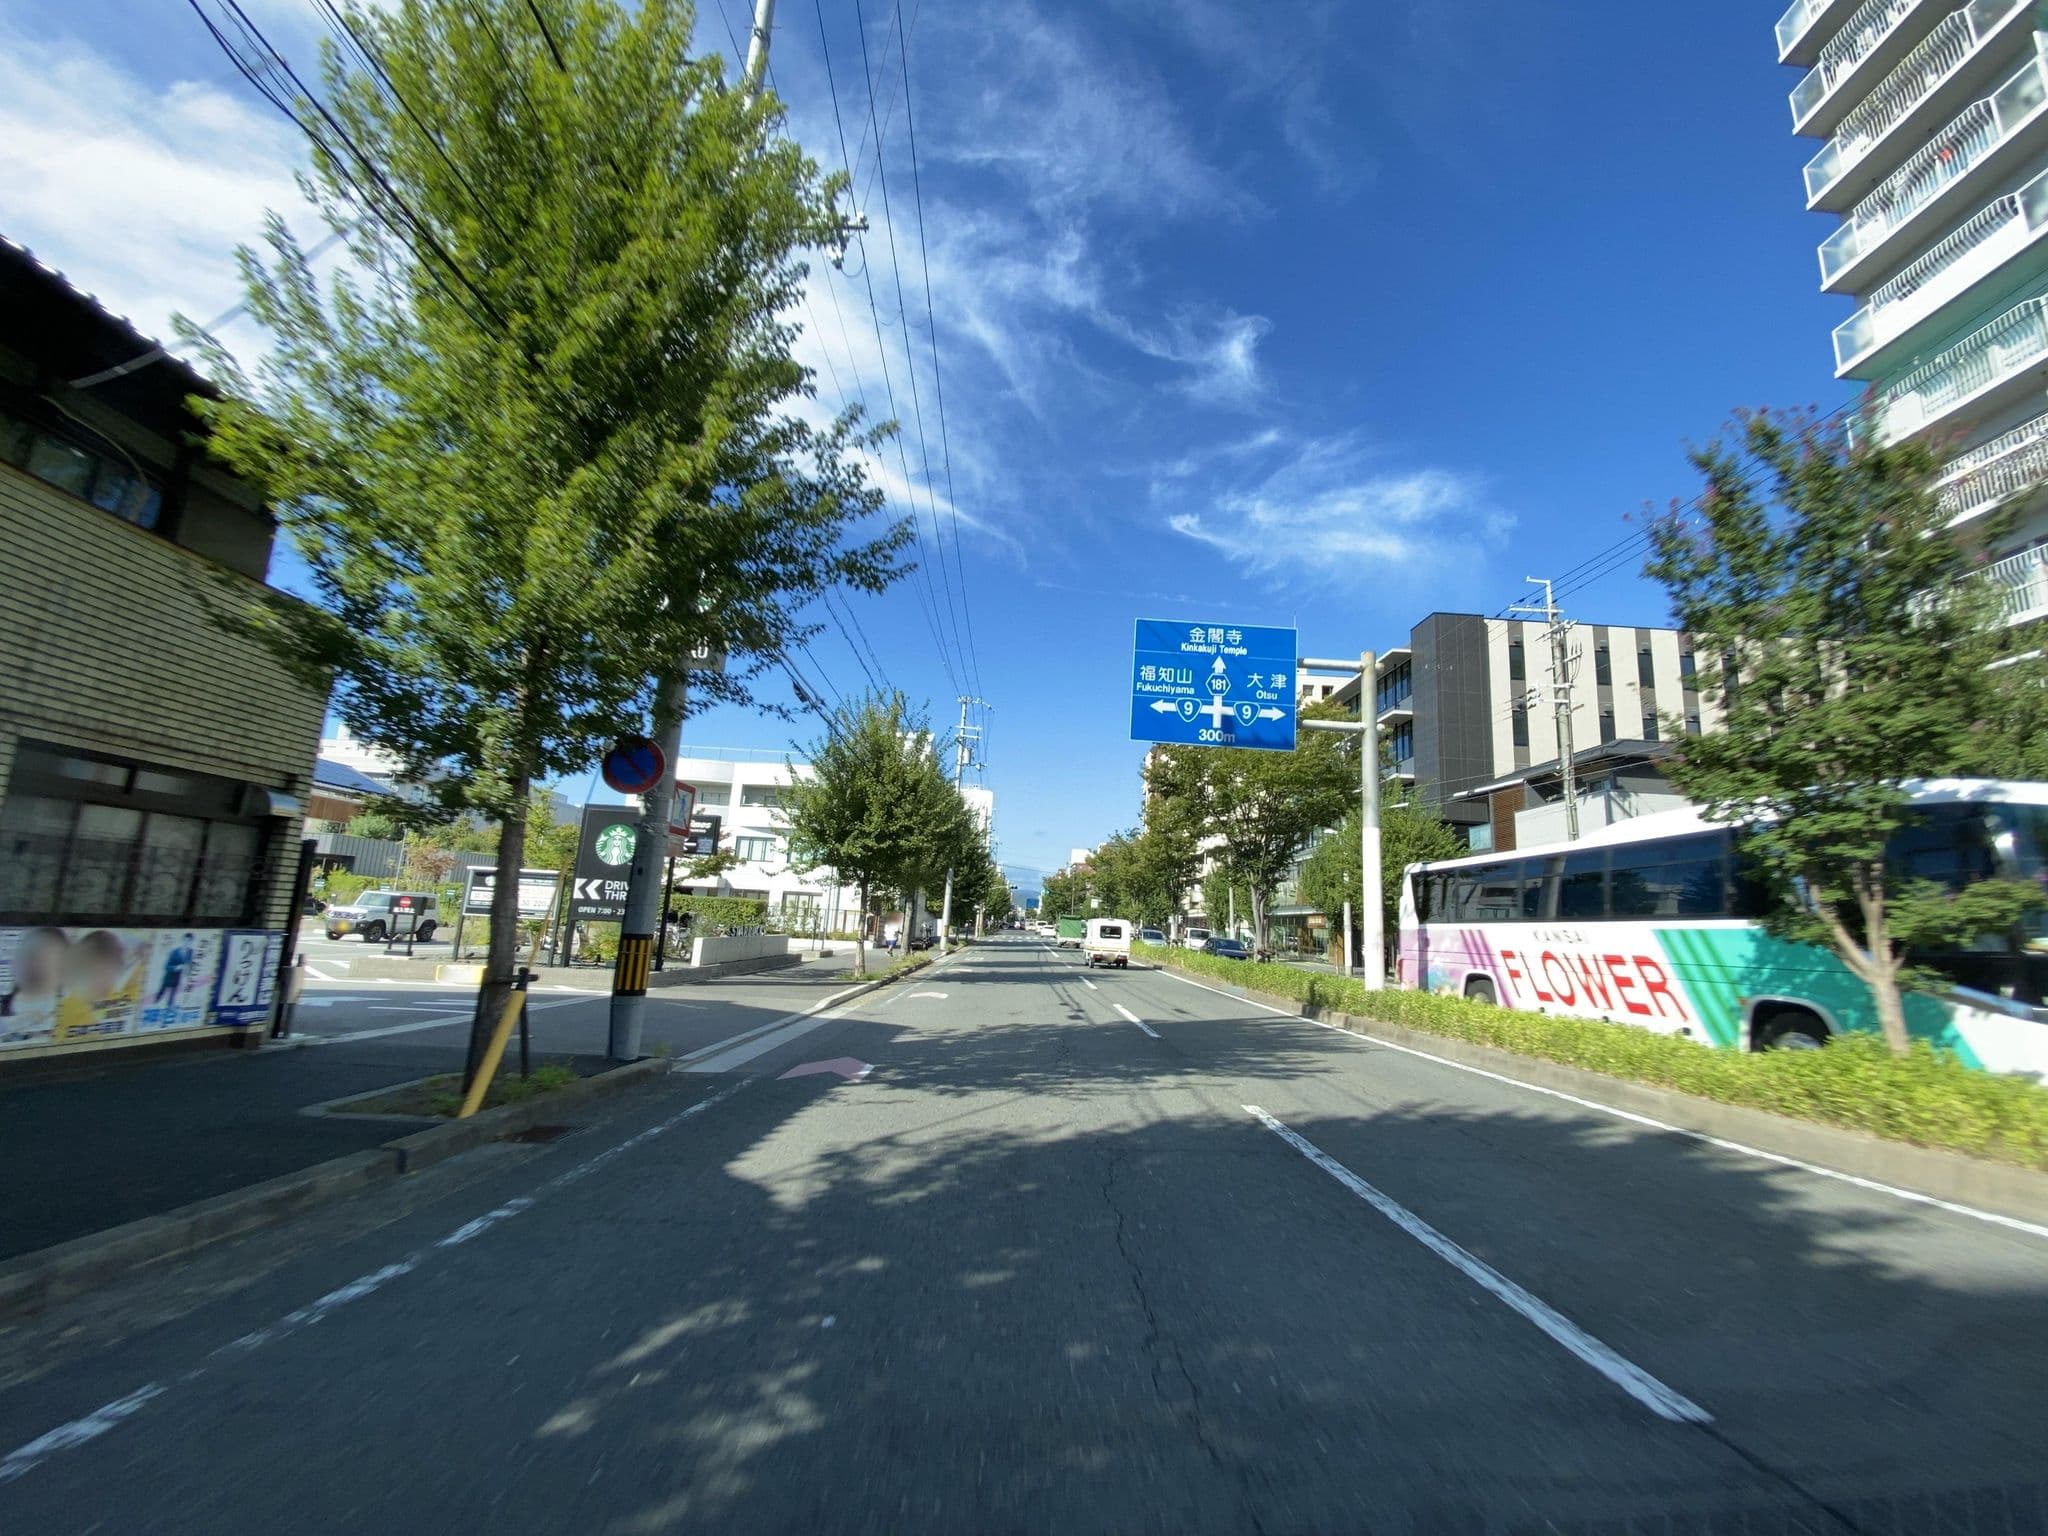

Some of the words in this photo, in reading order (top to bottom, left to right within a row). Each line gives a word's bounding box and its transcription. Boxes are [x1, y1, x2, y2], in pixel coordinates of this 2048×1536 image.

[1189, 626, 1243, 645] 金閣寺
[1181, 642, 1217, 655] Kinkakuji
[1219, 645, 1248, 657] Temple
[1140, 664, 1193, 684] 福知山
[1246, 672, 1288, 690] 大津
[1136, 682, 1195, 695] Fukuchiyama
[1210, 678, 1227, 691] 181
[1255, 690, 1278, 700] Otsu
[1183, 701, 1194, 715] 9
[1241, 705, 1252, 719] 9
[1198, 728, 1236, 743] 300m
[577, 906, 596, 914] OPEN
[1500, 950, 1689, 1021] FLOWER
